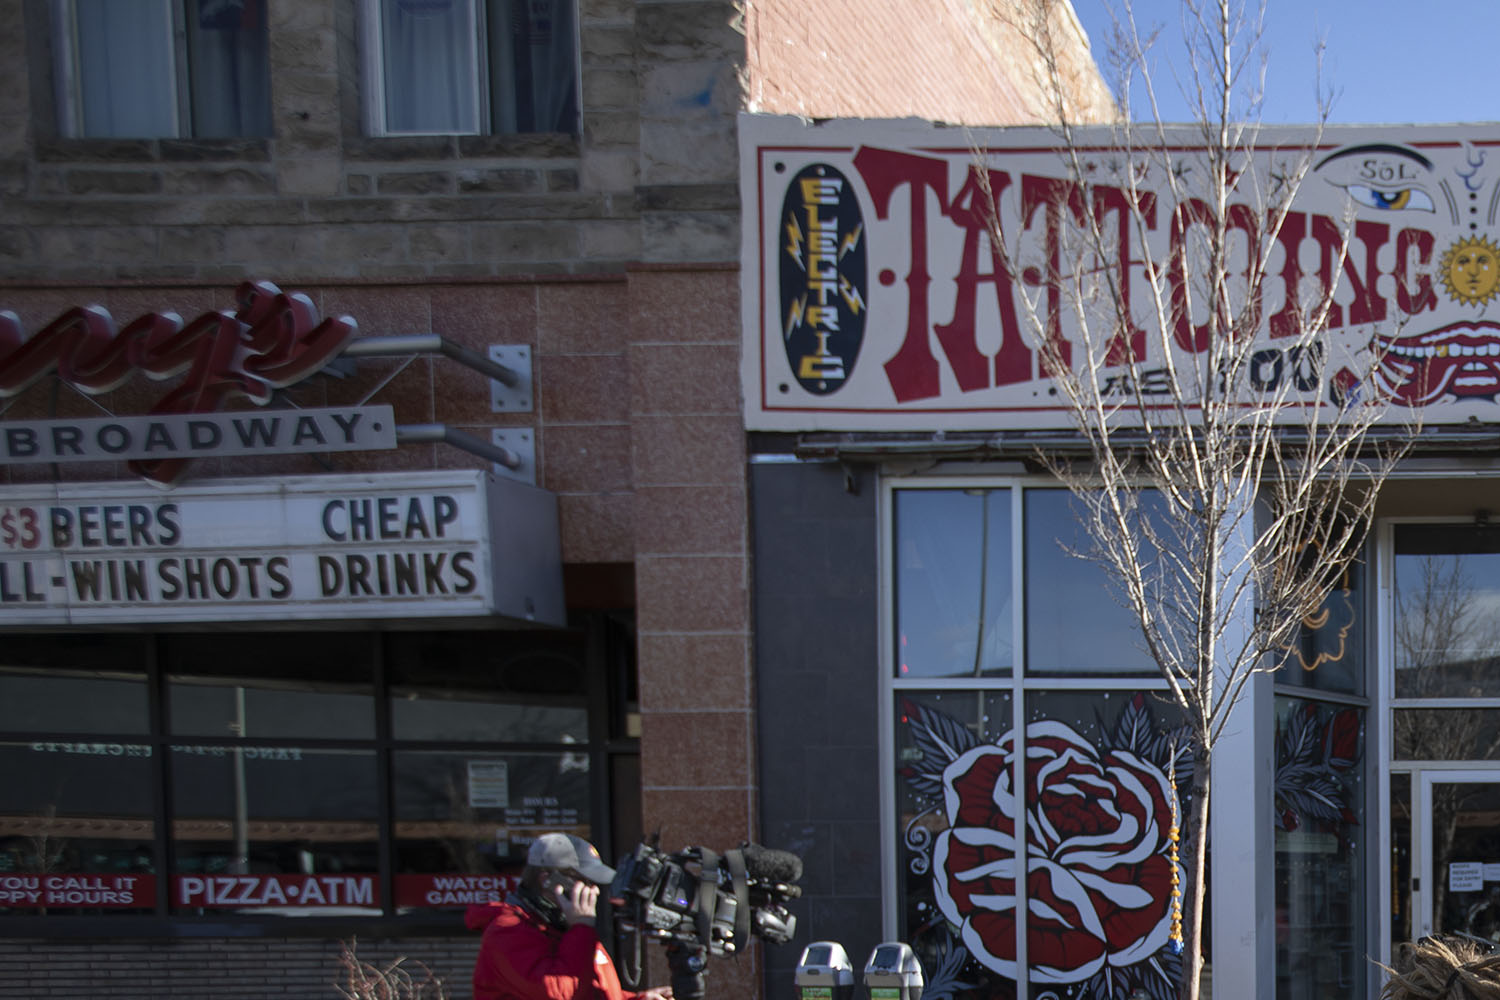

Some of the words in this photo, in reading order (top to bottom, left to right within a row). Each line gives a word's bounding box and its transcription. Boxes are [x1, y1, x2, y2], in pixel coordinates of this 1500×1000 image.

[799, 178, 844, 379] ELECTRIC
[852, 145, 1438, 403] TATTOOING
[1100, 368, 1177, 396] AS
[6, 413, 363, 457] BROADWAY
[1, 507, 41, 550] $3
[50, 503, 183, 549] BEERS
[321, 496, 459, 543] CHEAP
[158, 556, 293, 601] SHOTS
[318, 552, 478, 598] DRINKS
[44, 877, 111, 890] CALL
[115, 877, 137, 890] IT
[46, 891, 135, 904] HOURS
[426, 890, 502, 905] GAMES
[433, 877, 508, 890] WATCH
